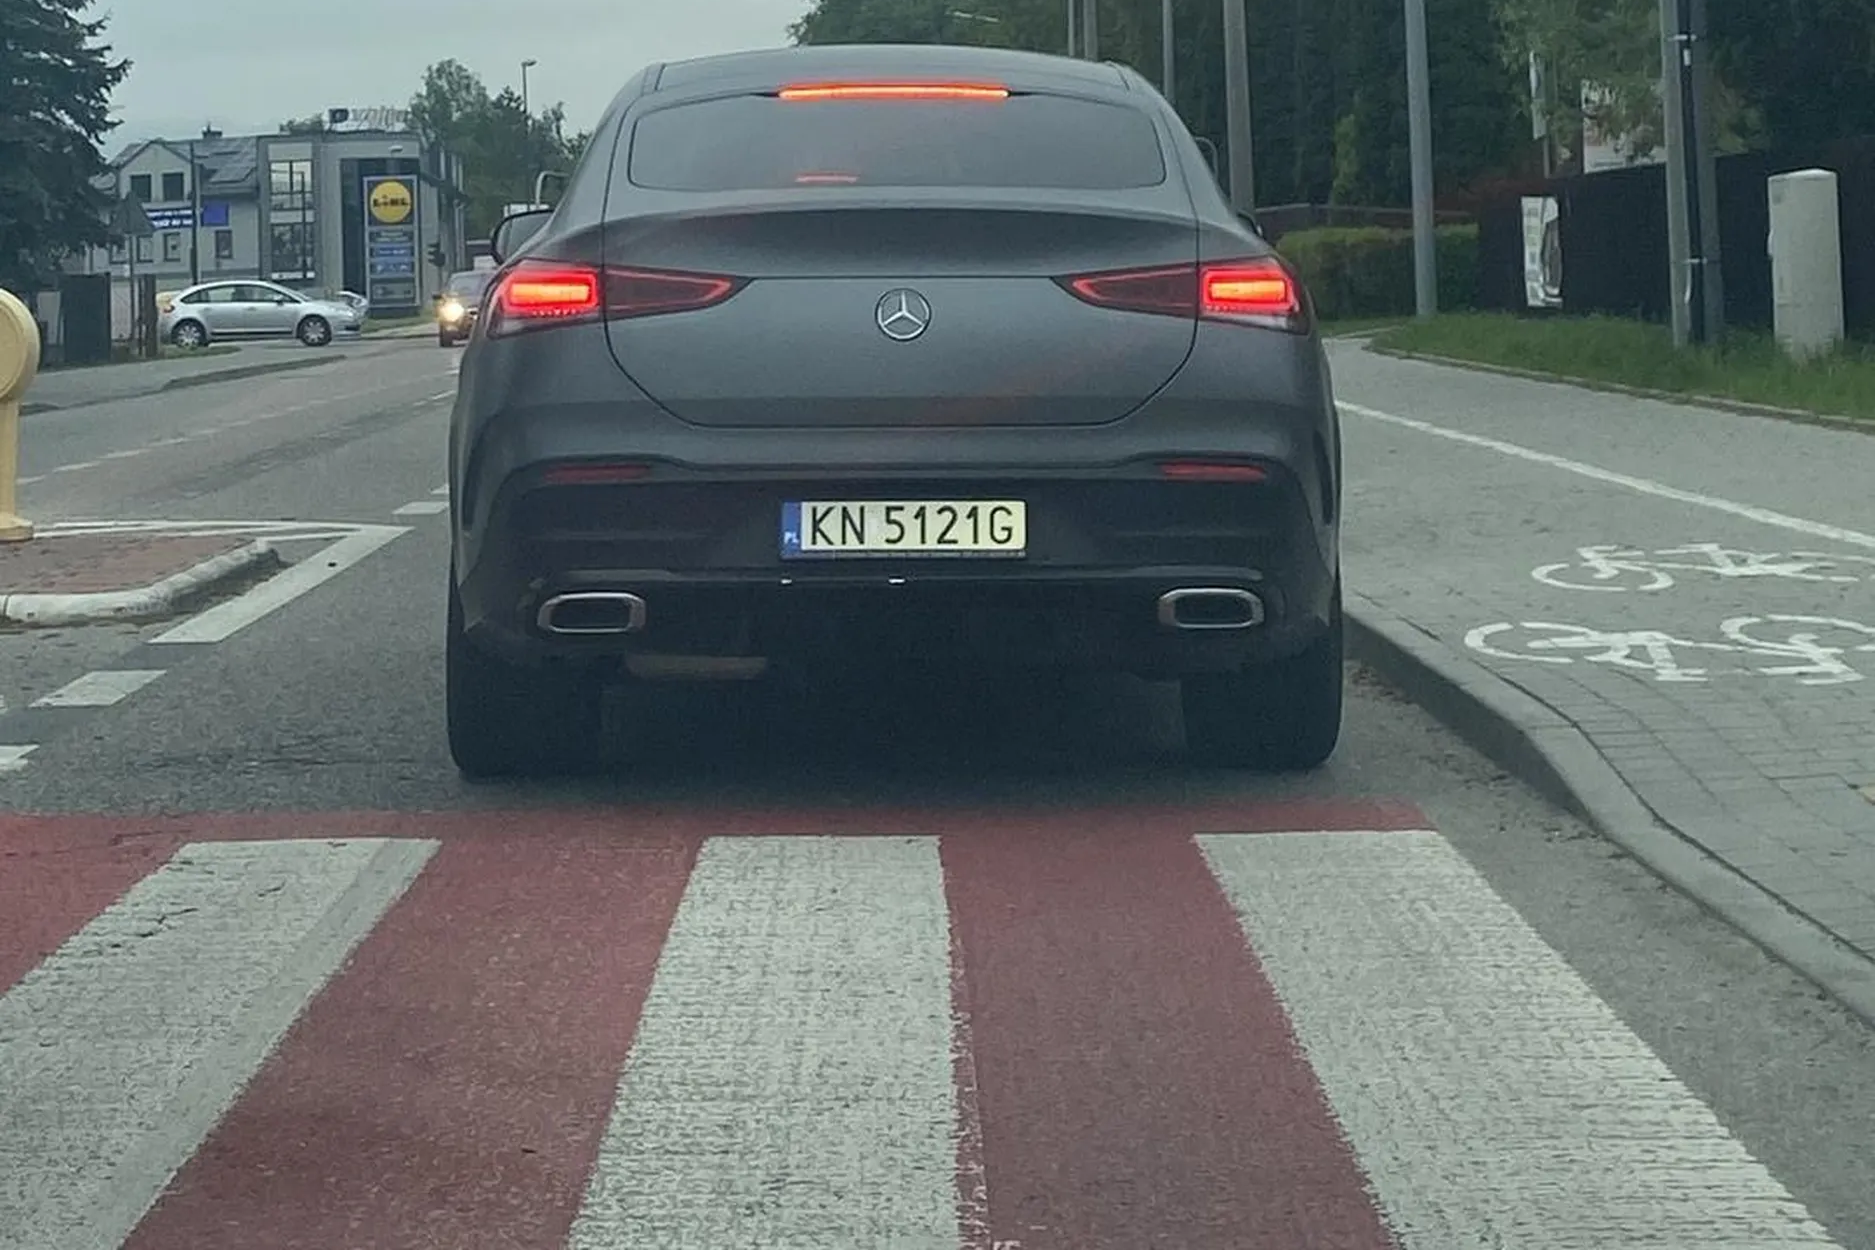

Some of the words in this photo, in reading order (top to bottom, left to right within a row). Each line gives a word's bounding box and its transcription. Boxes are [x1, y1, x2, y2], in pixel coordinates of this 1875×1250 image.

[784, 532, 799, 544] PL
[811, 505, 865, 545] KN
[884, 505, 1013, 545] 5121G
